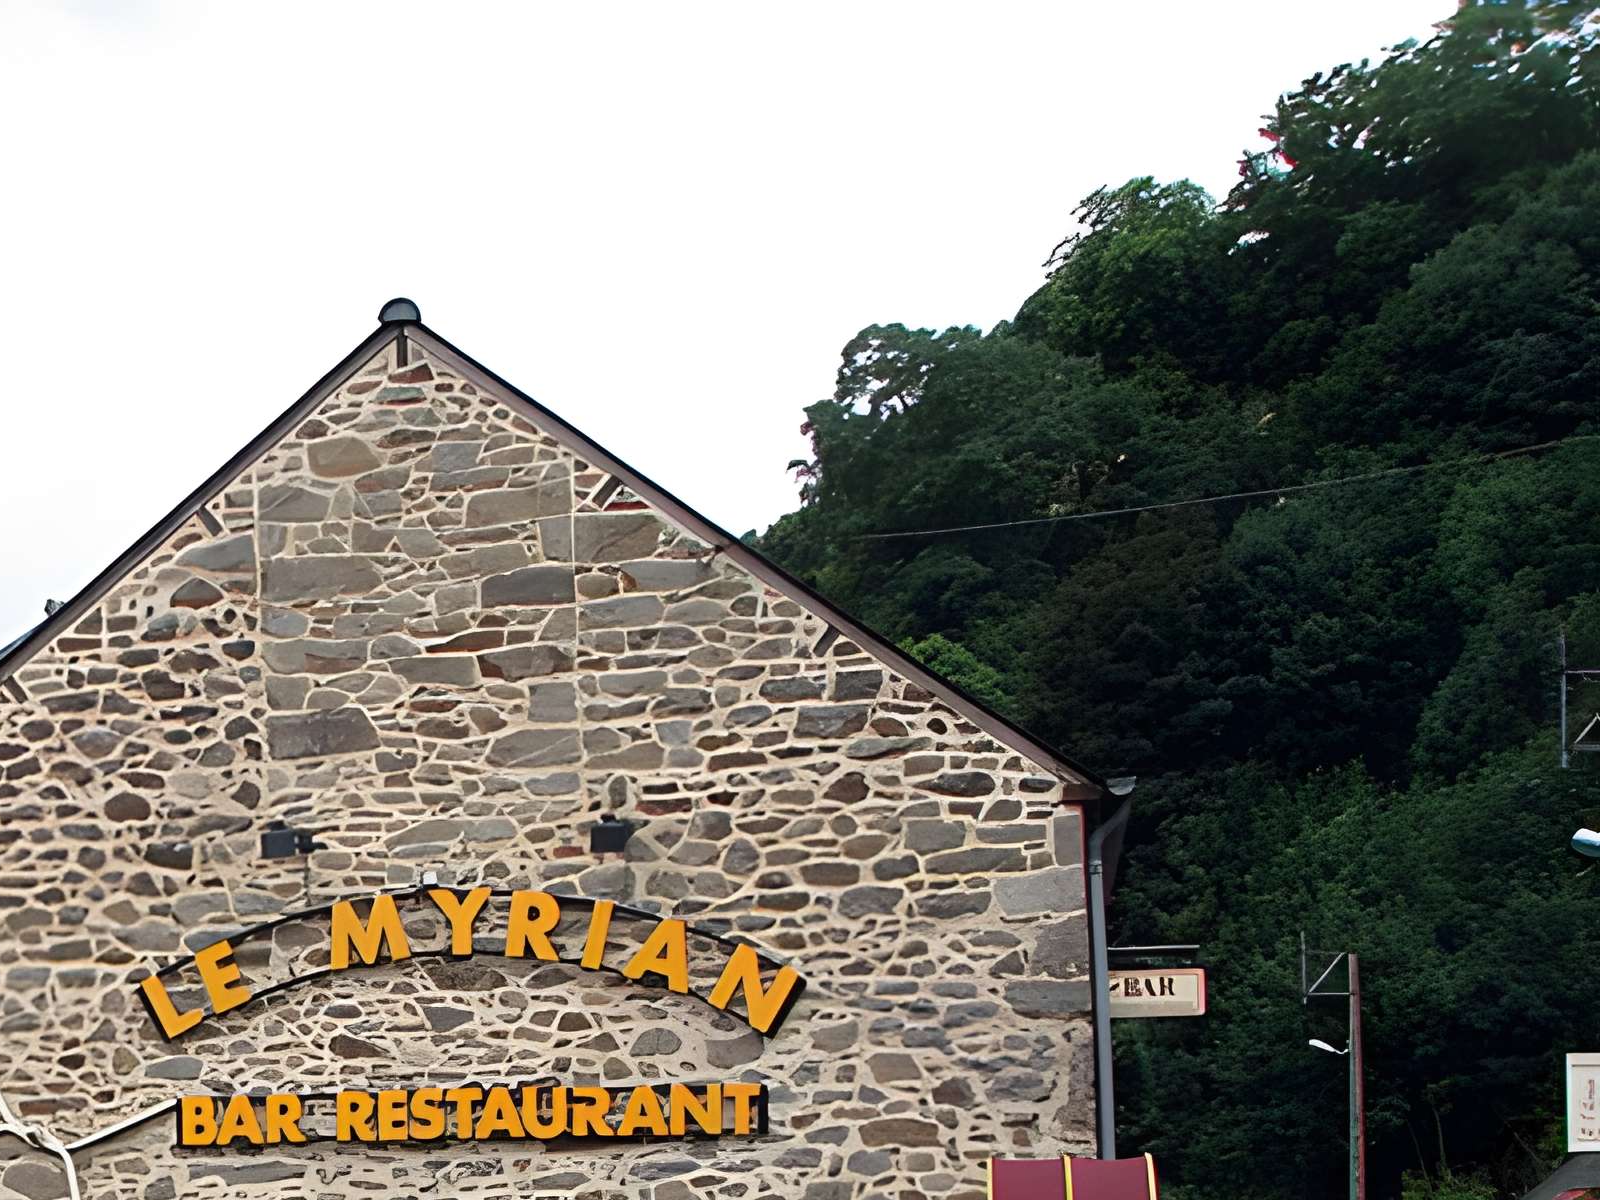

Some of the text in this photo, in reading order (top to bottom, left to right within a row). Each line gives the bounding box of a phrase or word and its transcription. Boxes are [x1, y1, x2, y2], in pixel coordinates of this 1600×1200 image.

[140, 886, 801, 1040] LE MYRIAN
[180, 1082, 761, 1146] BAR RESTAURANT
